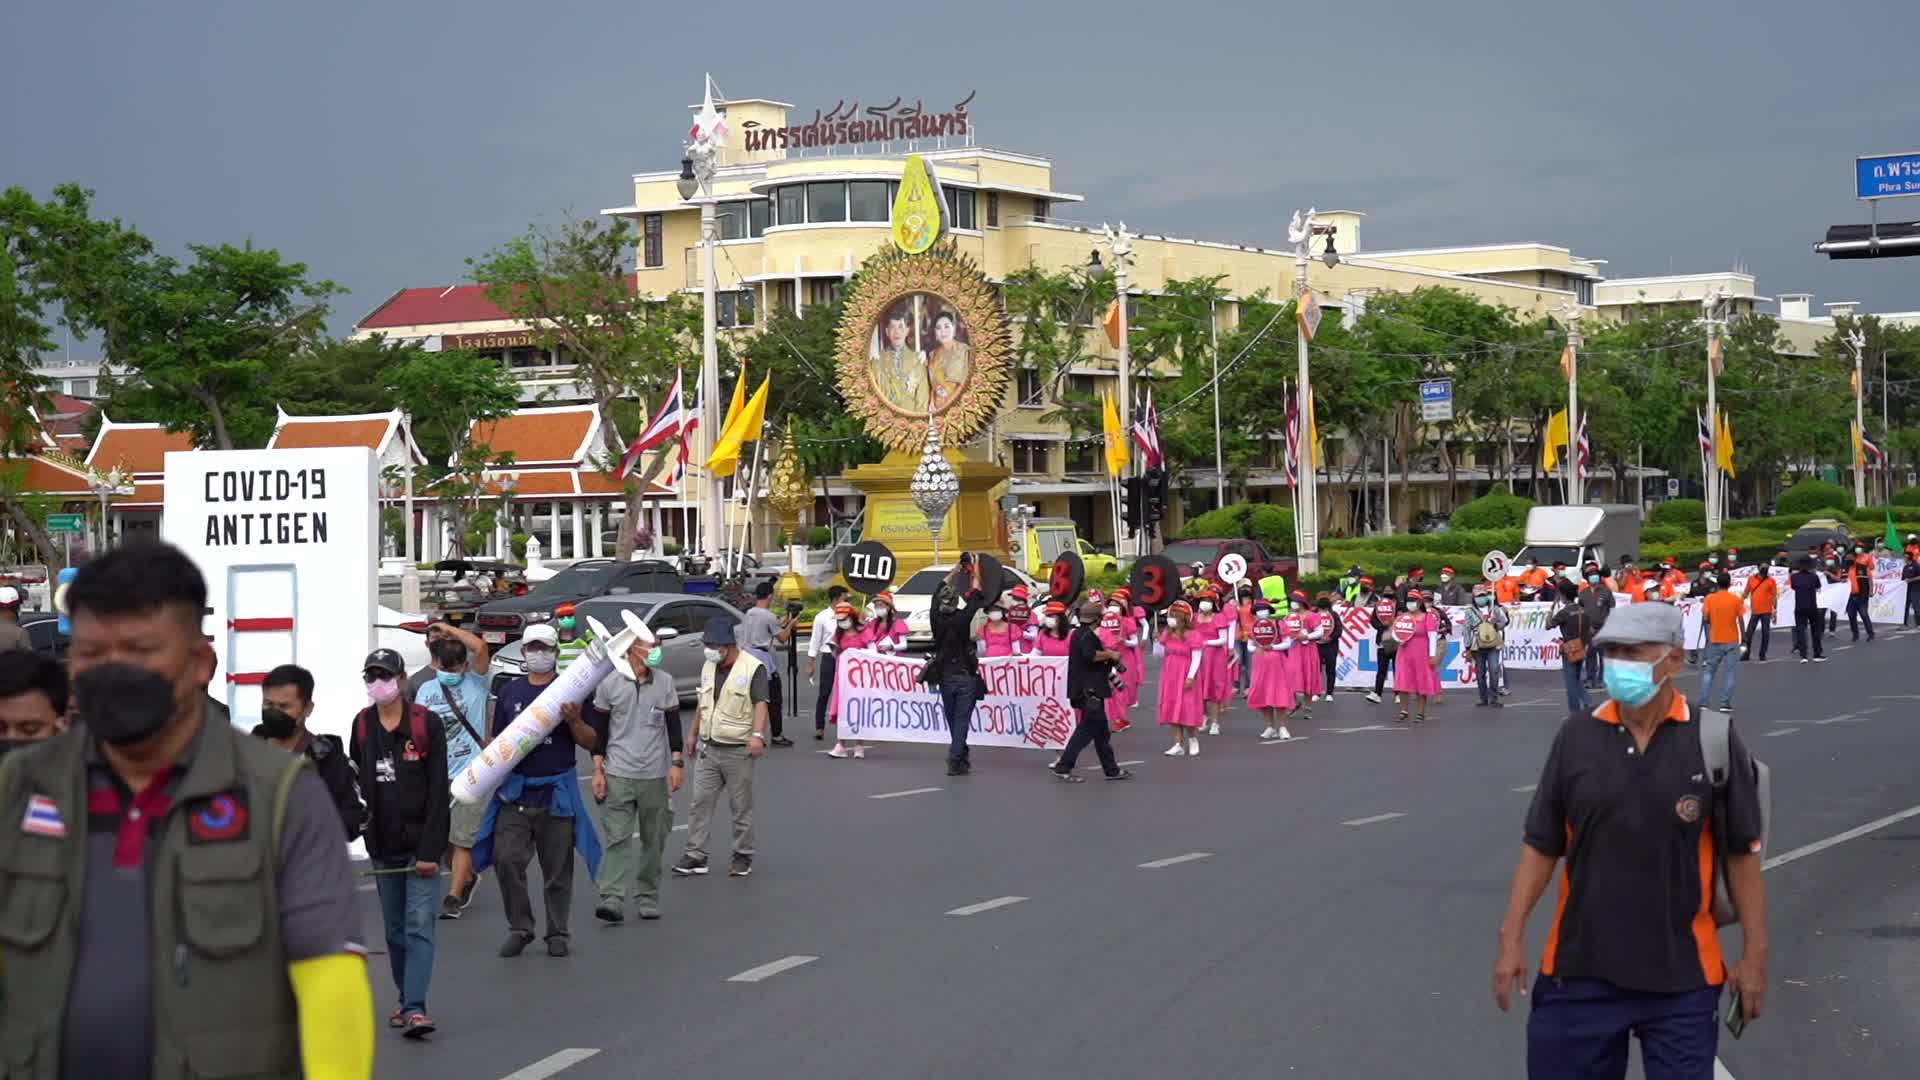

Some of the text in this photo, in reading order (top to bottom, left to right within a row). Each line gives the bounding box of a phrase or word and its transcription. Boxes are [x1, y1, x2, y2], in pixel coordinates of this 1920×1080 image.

[1878, 183, 1902, 193] Phra
[205, 469, 326, 503] COVID-19
[205, 512, 328, 546] ANTIGEN
[848, 553, 891, 580] ILO
[1139, 565, 1166, 604] 3
